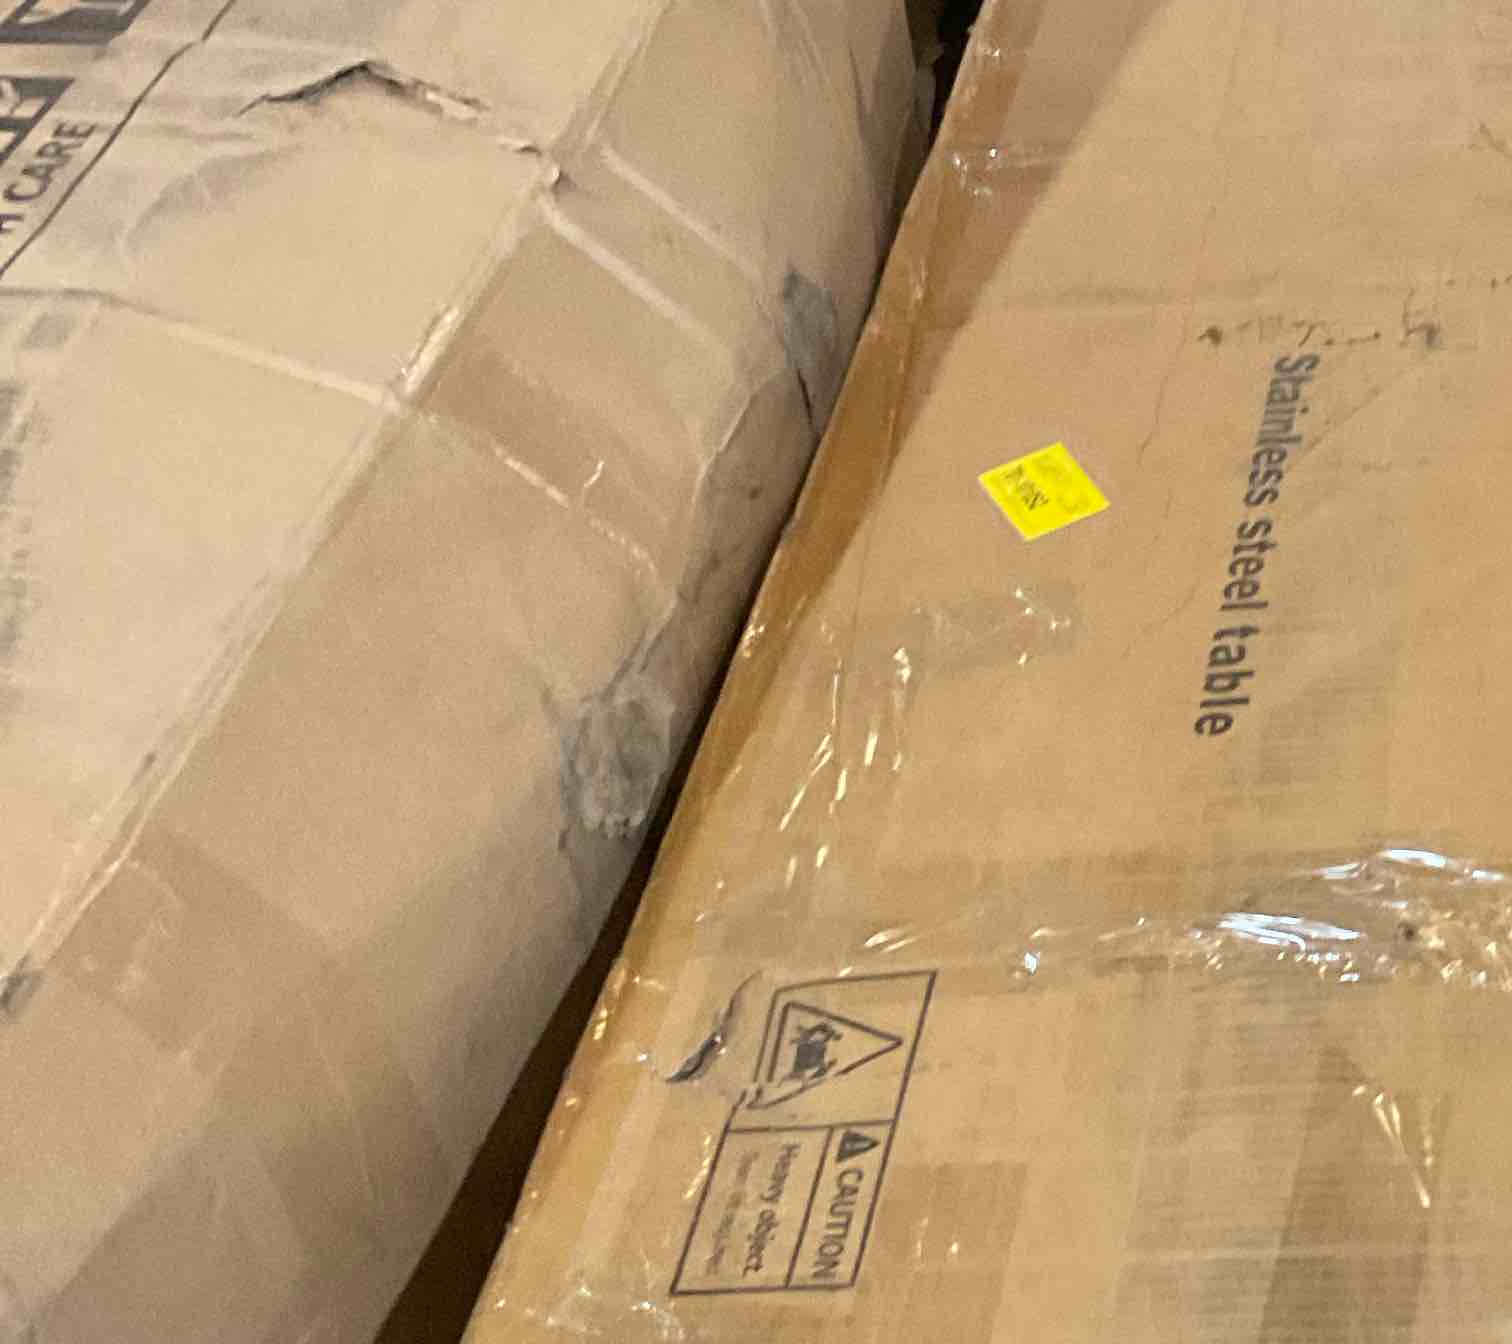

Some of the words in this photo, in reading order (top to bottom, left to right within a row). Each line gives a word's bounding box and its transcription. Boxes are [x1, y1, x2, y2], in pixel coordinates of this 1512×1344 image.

[2, 122, 98, 203] CARE
[1243, 354, 1320, 509] Stainless
[1219, 516, 1279, 612] steel
[1194, 624, 1261, 738] table
[760, 1143, 801, 1204] Heavy
[742, 1208, 779, 1277] object
[811, 1167, 864, 1278] CAUTION
